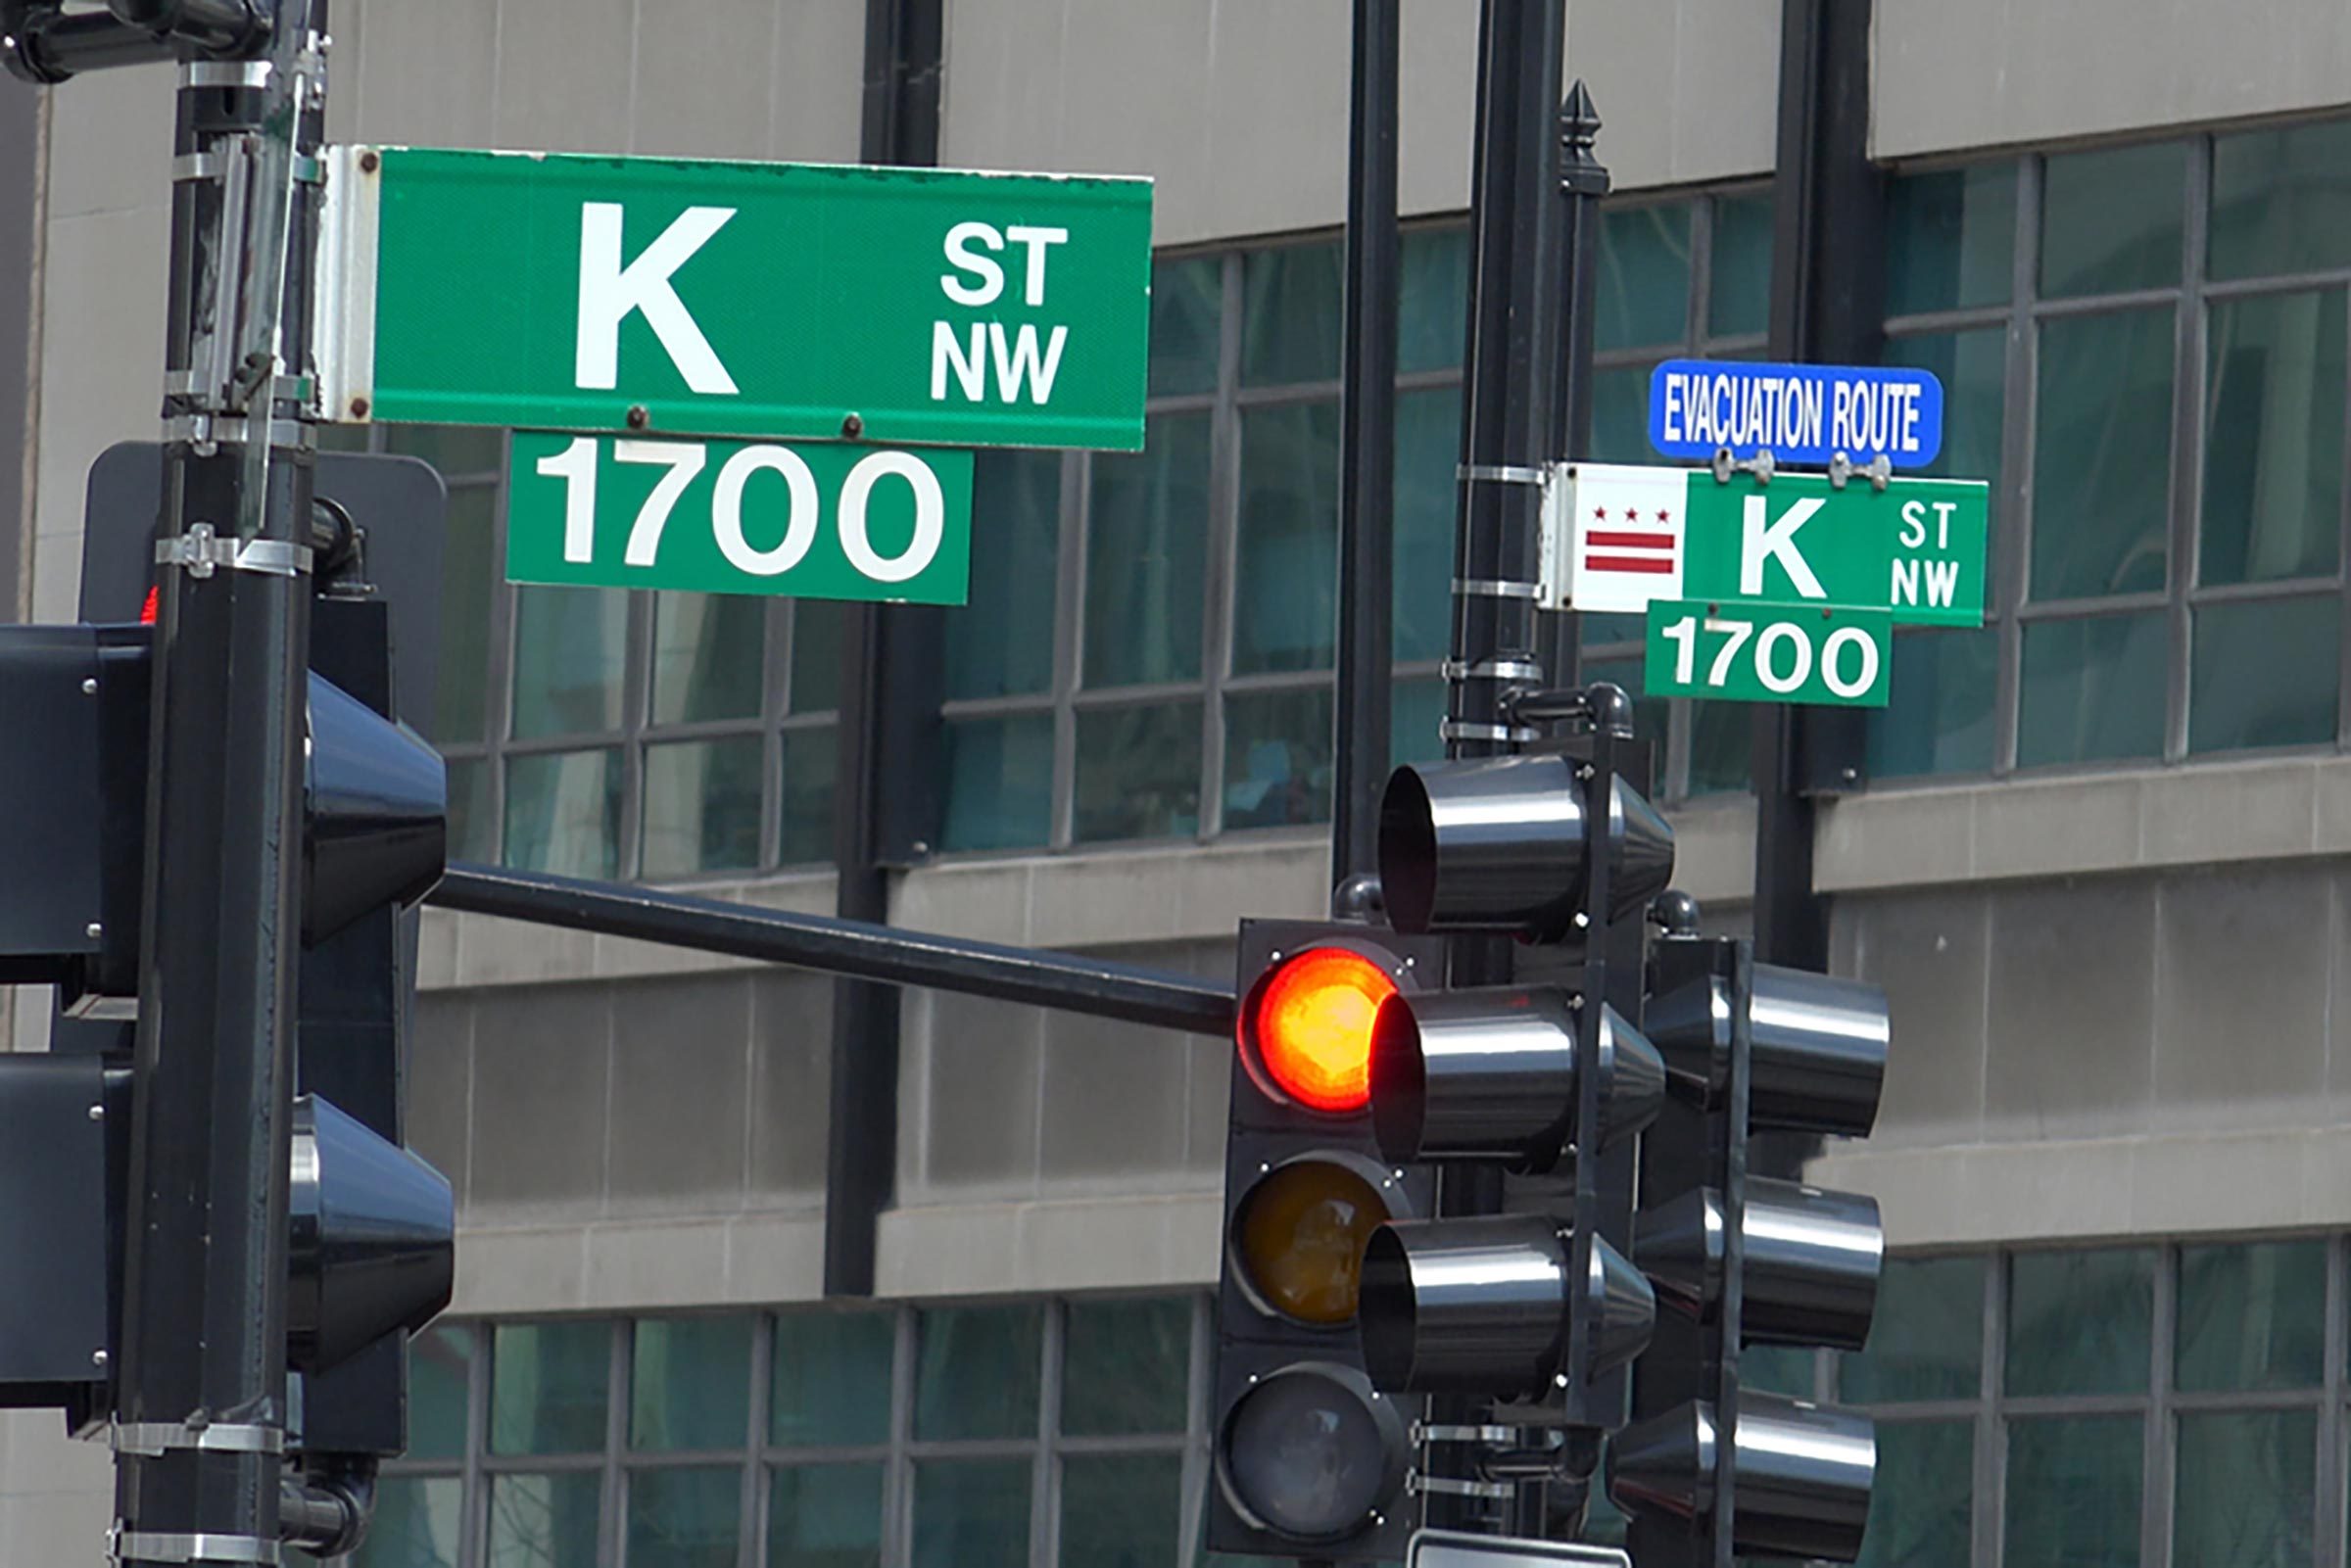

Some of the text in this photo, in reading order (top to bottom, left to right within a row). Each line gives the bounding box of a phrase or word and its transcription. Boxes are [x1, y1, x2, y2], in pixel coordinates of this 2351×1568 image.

[575, 202, 739, 395] K
[940, 221, 1069, 307] ST
[931, 321, 1068, 404] NW
[1664, 373, 1922, 451] EVACUATION ROUTE
[536, 437, 944, 583] 1700
[1740, 495, 1827, 598] K
[1899, 500, 1957, 549] ST
[1891, 558, 1959, 608] NW
[1661, 616, 1879, 698] 1700
